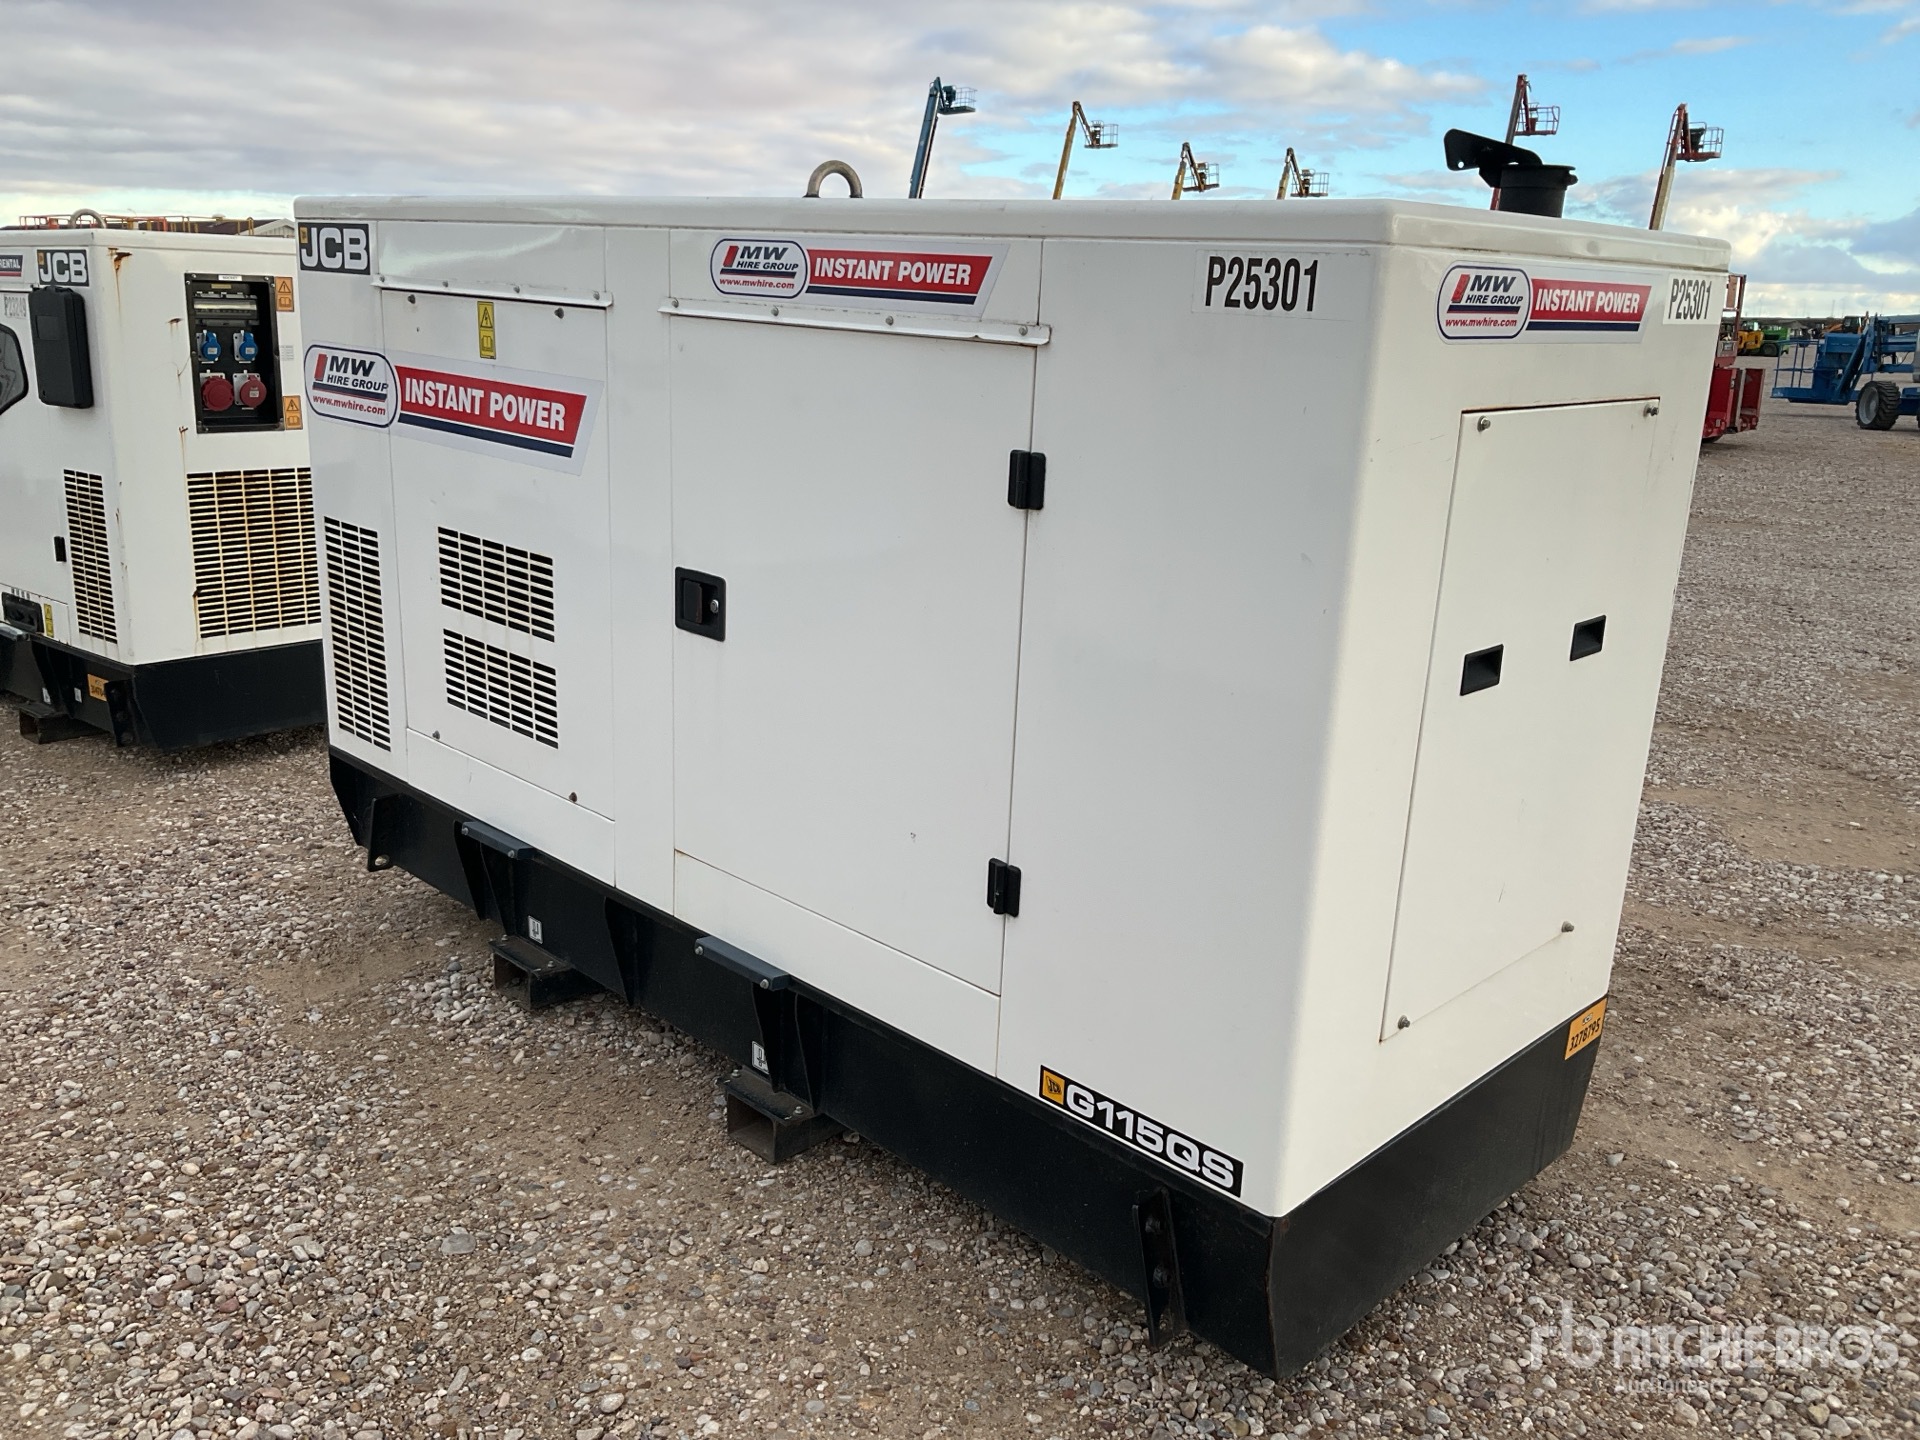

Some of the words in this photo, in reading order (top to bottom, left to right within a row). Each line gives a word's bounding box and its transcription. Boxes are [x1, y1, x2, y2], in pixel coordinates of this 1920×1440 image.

[300, 227, 369, 270] JCB
[740, 246, 788, 259] MW
[40, 252, 87, 282] JCB
[736, 260, 761, 270] HIRE
[763, 263, 799, 272] GROUP
[814, 258, 893, 281] INSTANT
[898, 261, 971, 286] POWER
[719, 279, 795, 290] www.mwhire.com
[1205, 256, 1318, 311] P25301
[1469, 275, 1516, 293] MW
[1465, 294, 1489, 305] HIRE
[1490, 295, 1523, 305] GROUP
[1534, 289, 1592, 313] INSTANT
[1595, 291, 1641, 314] POWER
[1667, 278, 1713, 320] P25301
[1445, 317, 1517, 328] www.mwhire.com
[329, 355, 376, 378] MW
[327, 374, 350, 387] HIRE
[351, 378, 389, 392] GROUP
[312, 395, 386, 416] www.mwhire.com
[405, 377, 485, 415] INSTANT
[489, 392, 565, 431] POWER
[1066, 1084, 1234, 1189] G115QS
